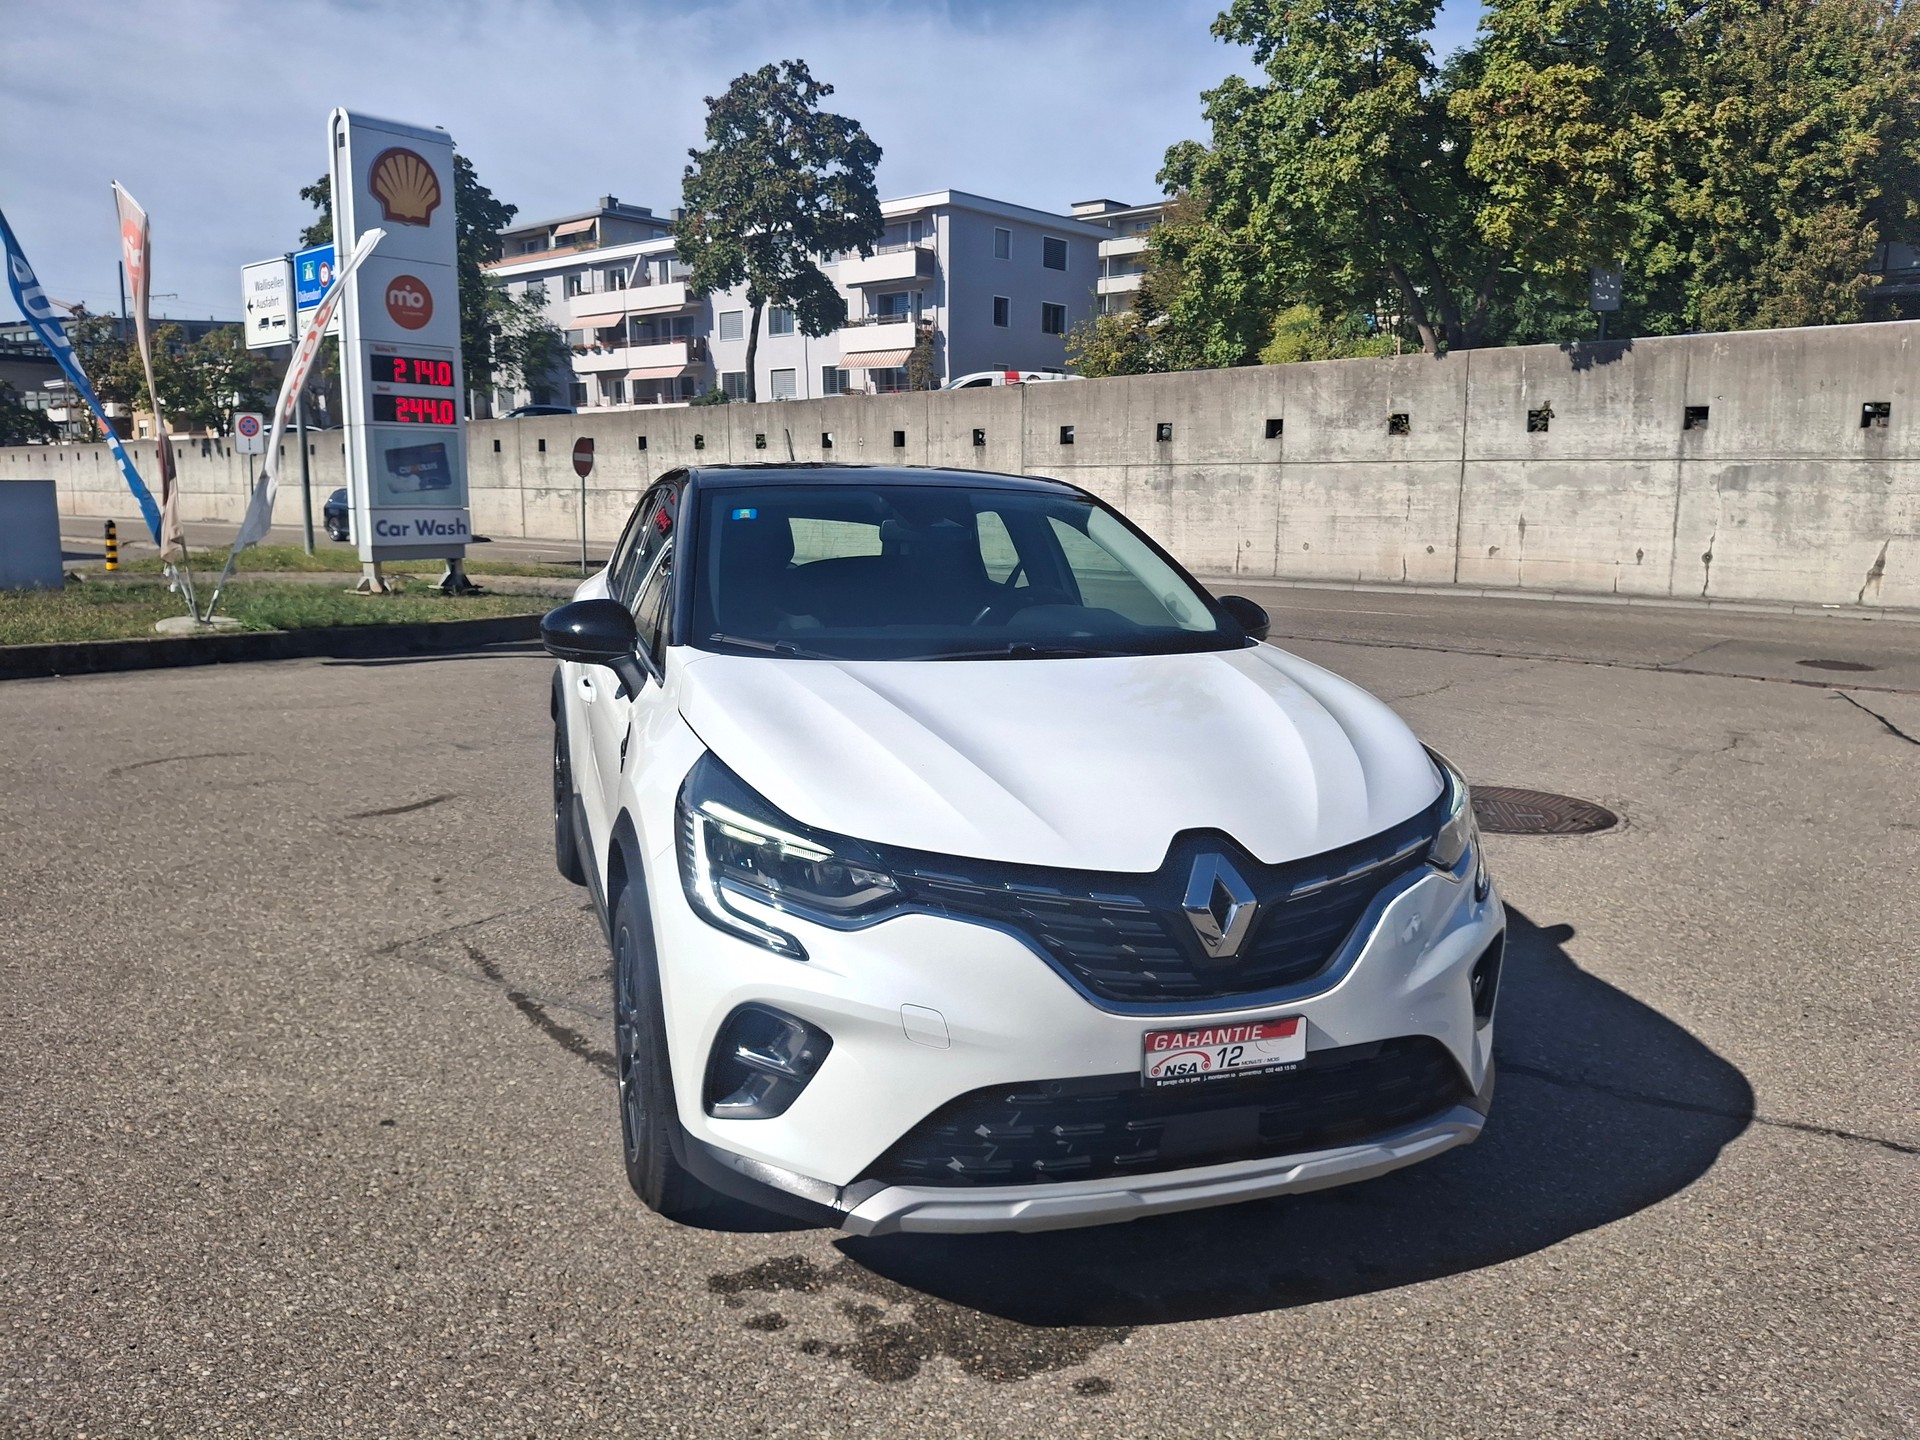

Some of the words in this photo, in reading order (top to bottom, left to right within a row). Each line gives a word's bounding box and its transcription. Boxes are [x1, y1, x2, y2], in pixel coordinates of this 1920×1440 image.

[254, 277, 285, 291] Wallisellen
[256, 296, 280, 309] Ausfahrt
[389, 284, 424, 308] mio
[395, 397, 454, 425] 244.0
[375, 519, 410, 537] Car
[415, 517, 467, 536] Wash
[1153, 1025, 1264, 1051] GARANTIE
[1216, 1045, 1244, 1068] 12
[1163, 1062, 1198, 1076] NSA
